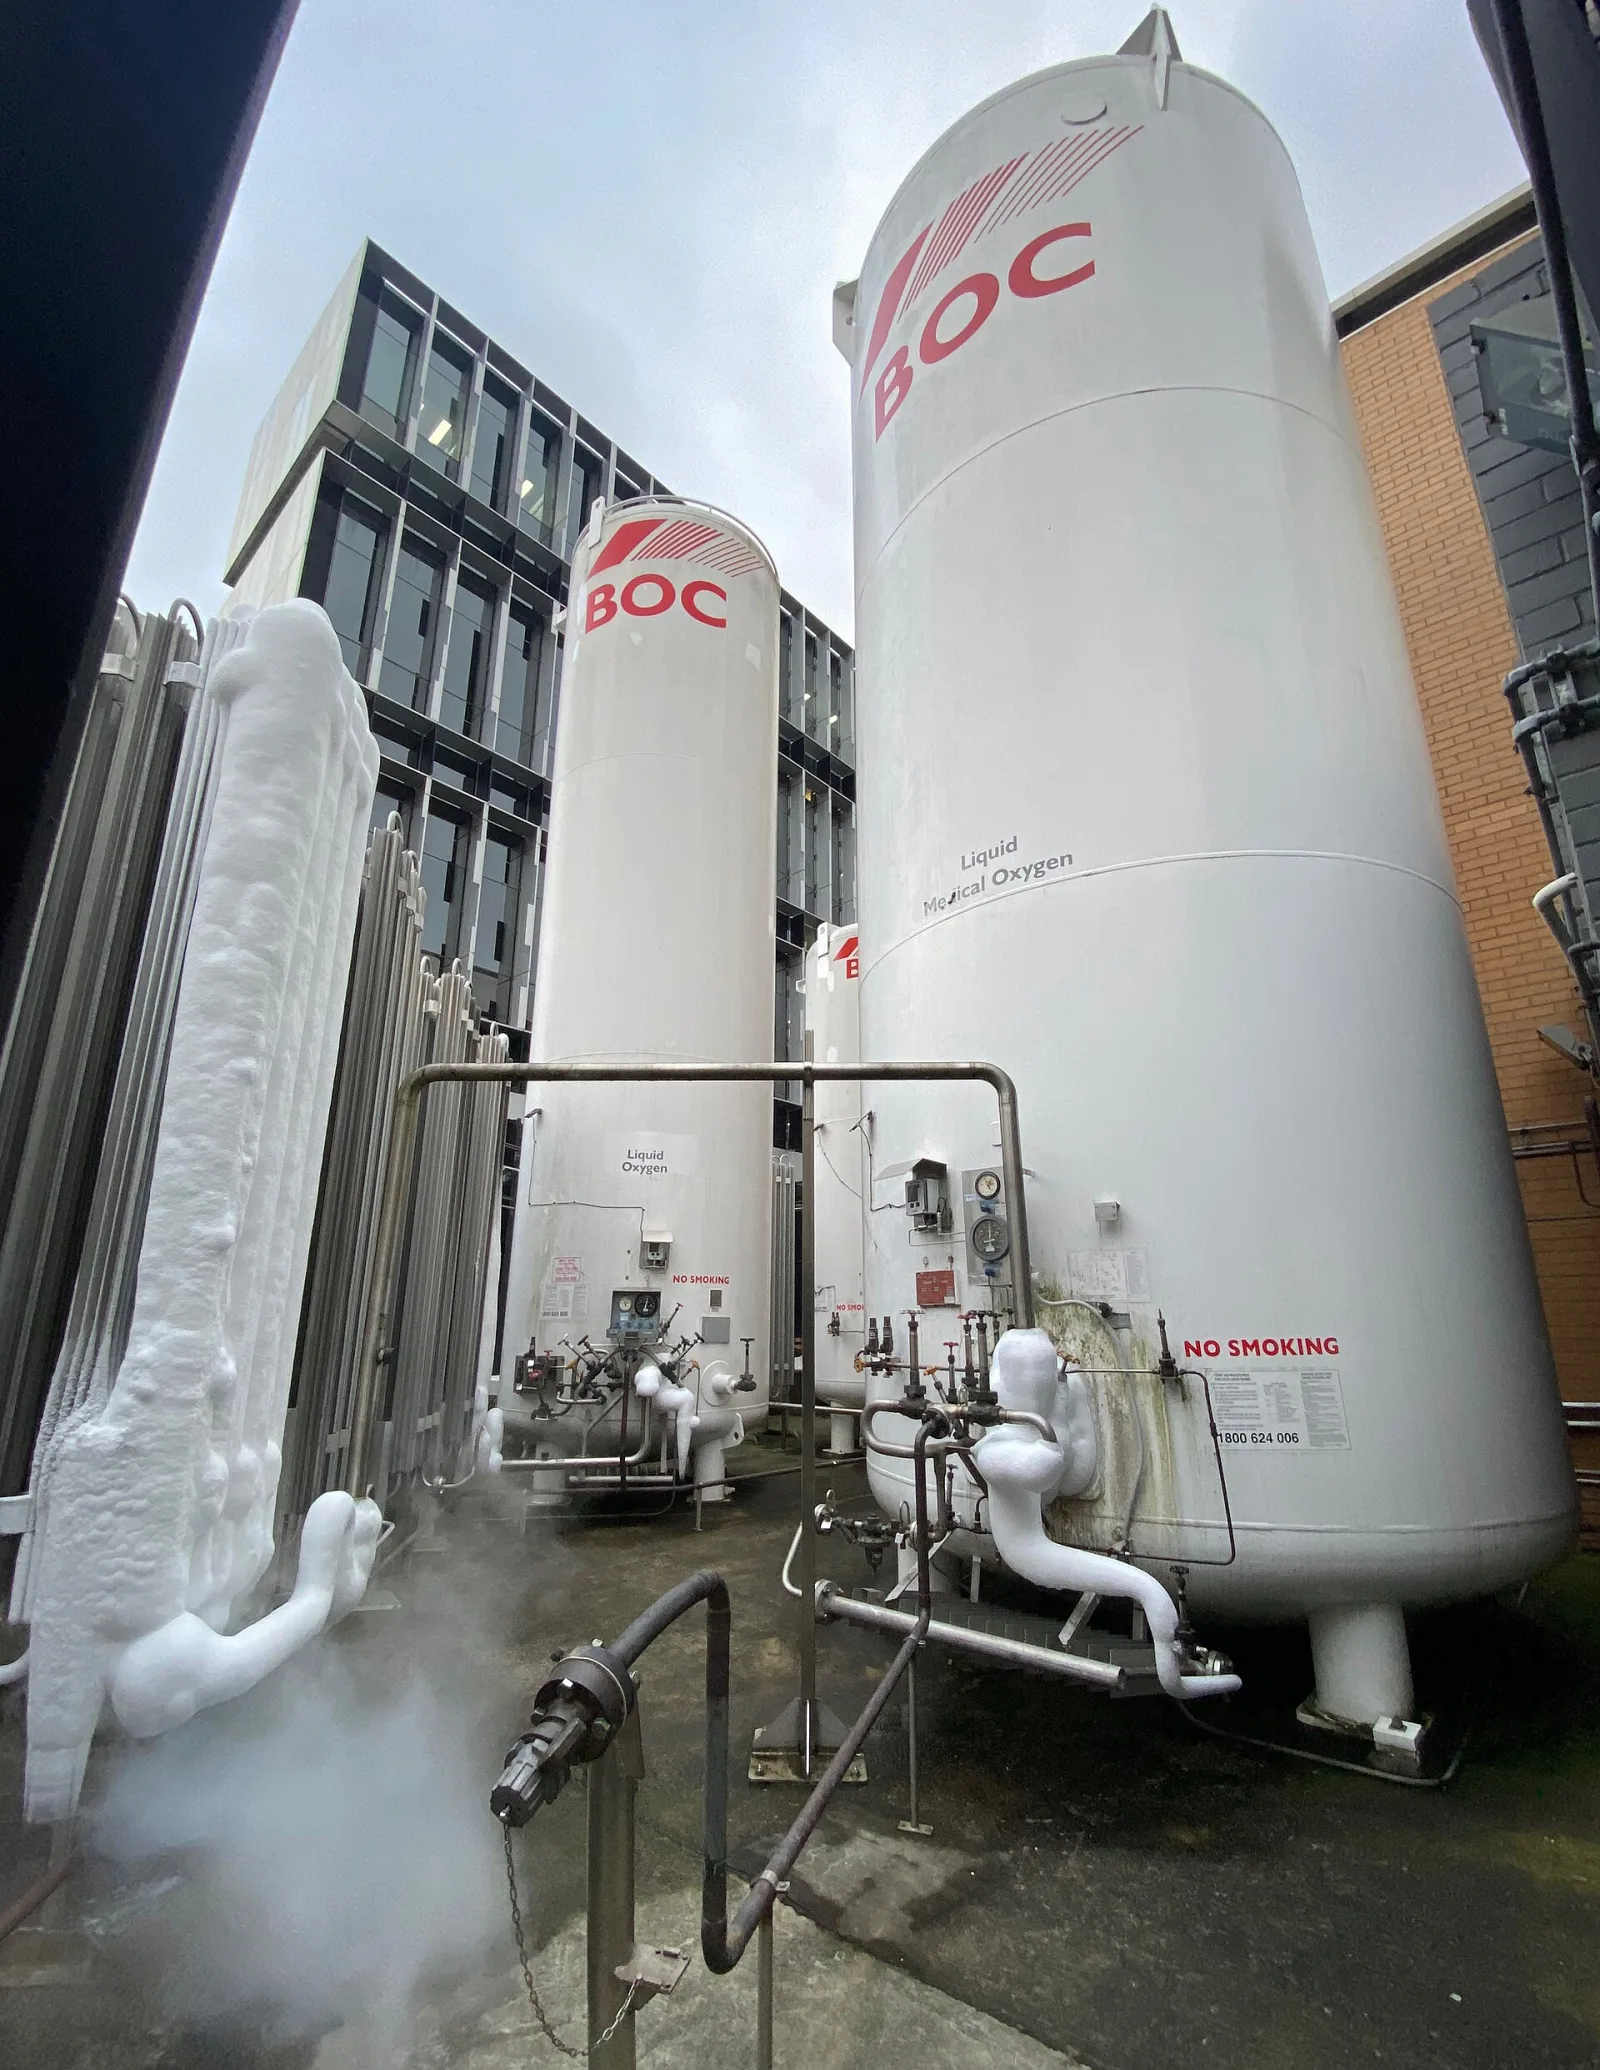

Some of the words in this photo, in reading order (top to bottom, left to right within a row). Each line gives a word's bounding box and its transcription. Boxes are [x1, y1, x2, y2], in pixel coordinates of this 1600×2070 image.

[874, 222, 1096, 444] BOC
[584, 573, 727, 635] BOC
[961, 835, 1018, 871] Liquid
[991, 853, 1073, 886] Oxygen
[627, 1149, 664, 1163] Liquid
[621, 1161, 668, 1175] Oxygen
[672, 1274, 688, 1284] NO
[689, 1274, 730, 1285] SMOKING
[1183, 1339, 1221, 1358] NO
[1227, 1337, 1340, 1357] SMOKING
[1219, 1432, 1247, 1444] 1800
[1250, 1432, 1273, 1444] 624
[1276, 1432, 1299, 1444] 006
